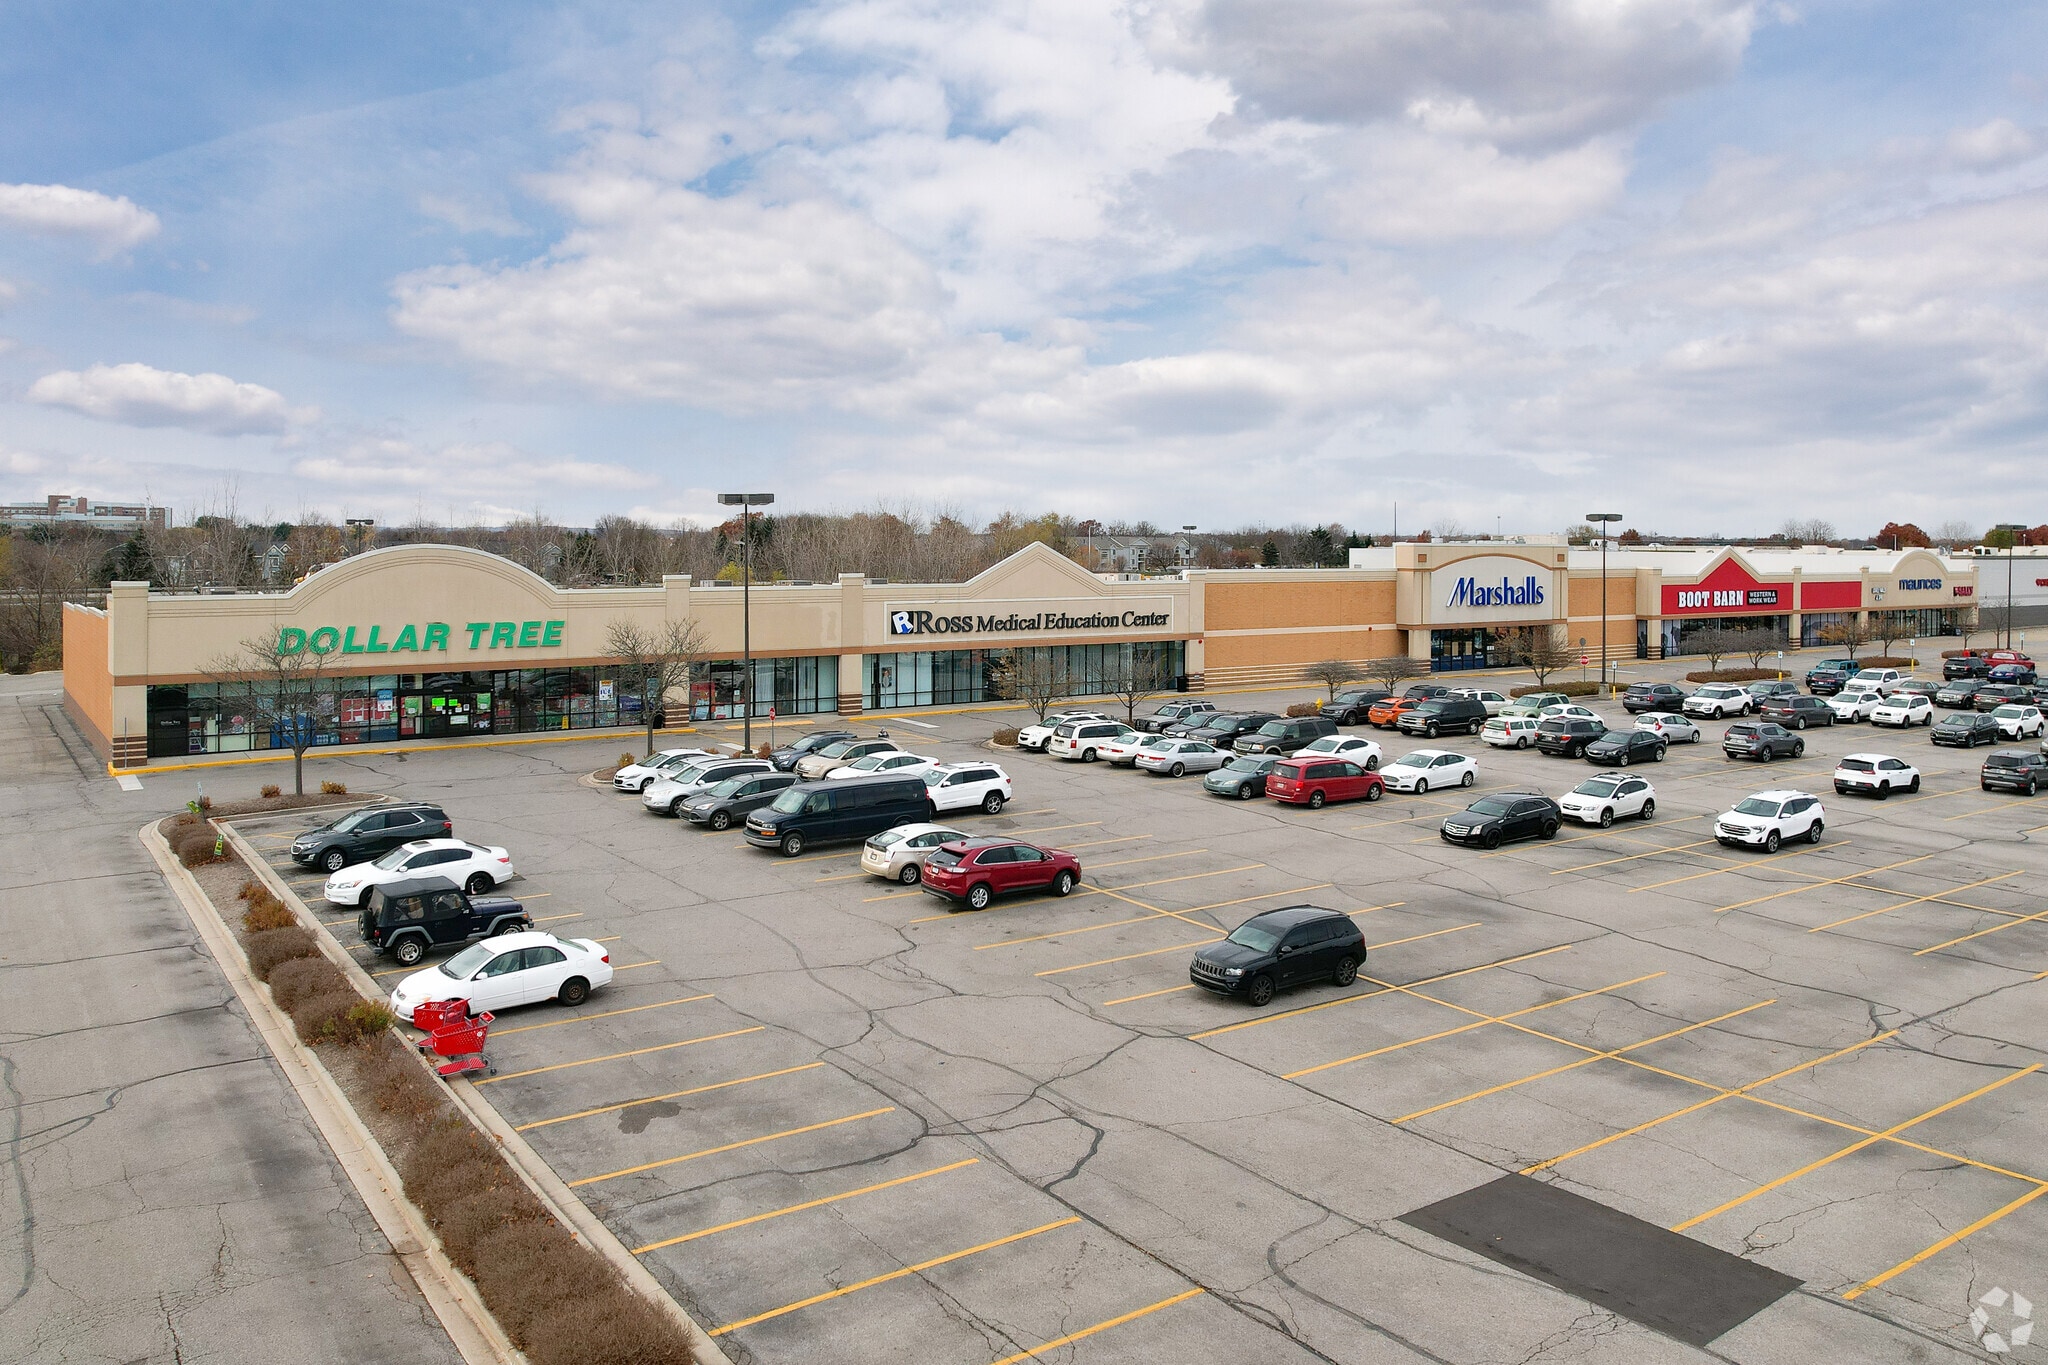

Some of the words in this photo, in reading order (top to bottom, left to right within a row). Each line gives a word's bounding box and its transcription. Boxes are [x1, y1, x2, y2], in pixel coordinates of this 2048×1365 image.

[1446, 576, 1544, 607] Marshalls
[1678, 591, 1710, 608] BOOT
[1713, 590, 1744, 607] BARN
[975, 613, 1041, 632] Medical
[1044, 612, 1120, 630] Education
[1122, 610, 1170, 627] Center
[277, 622, 451, 656] DOLLAR
[465, 620, 565, 650] TREE
